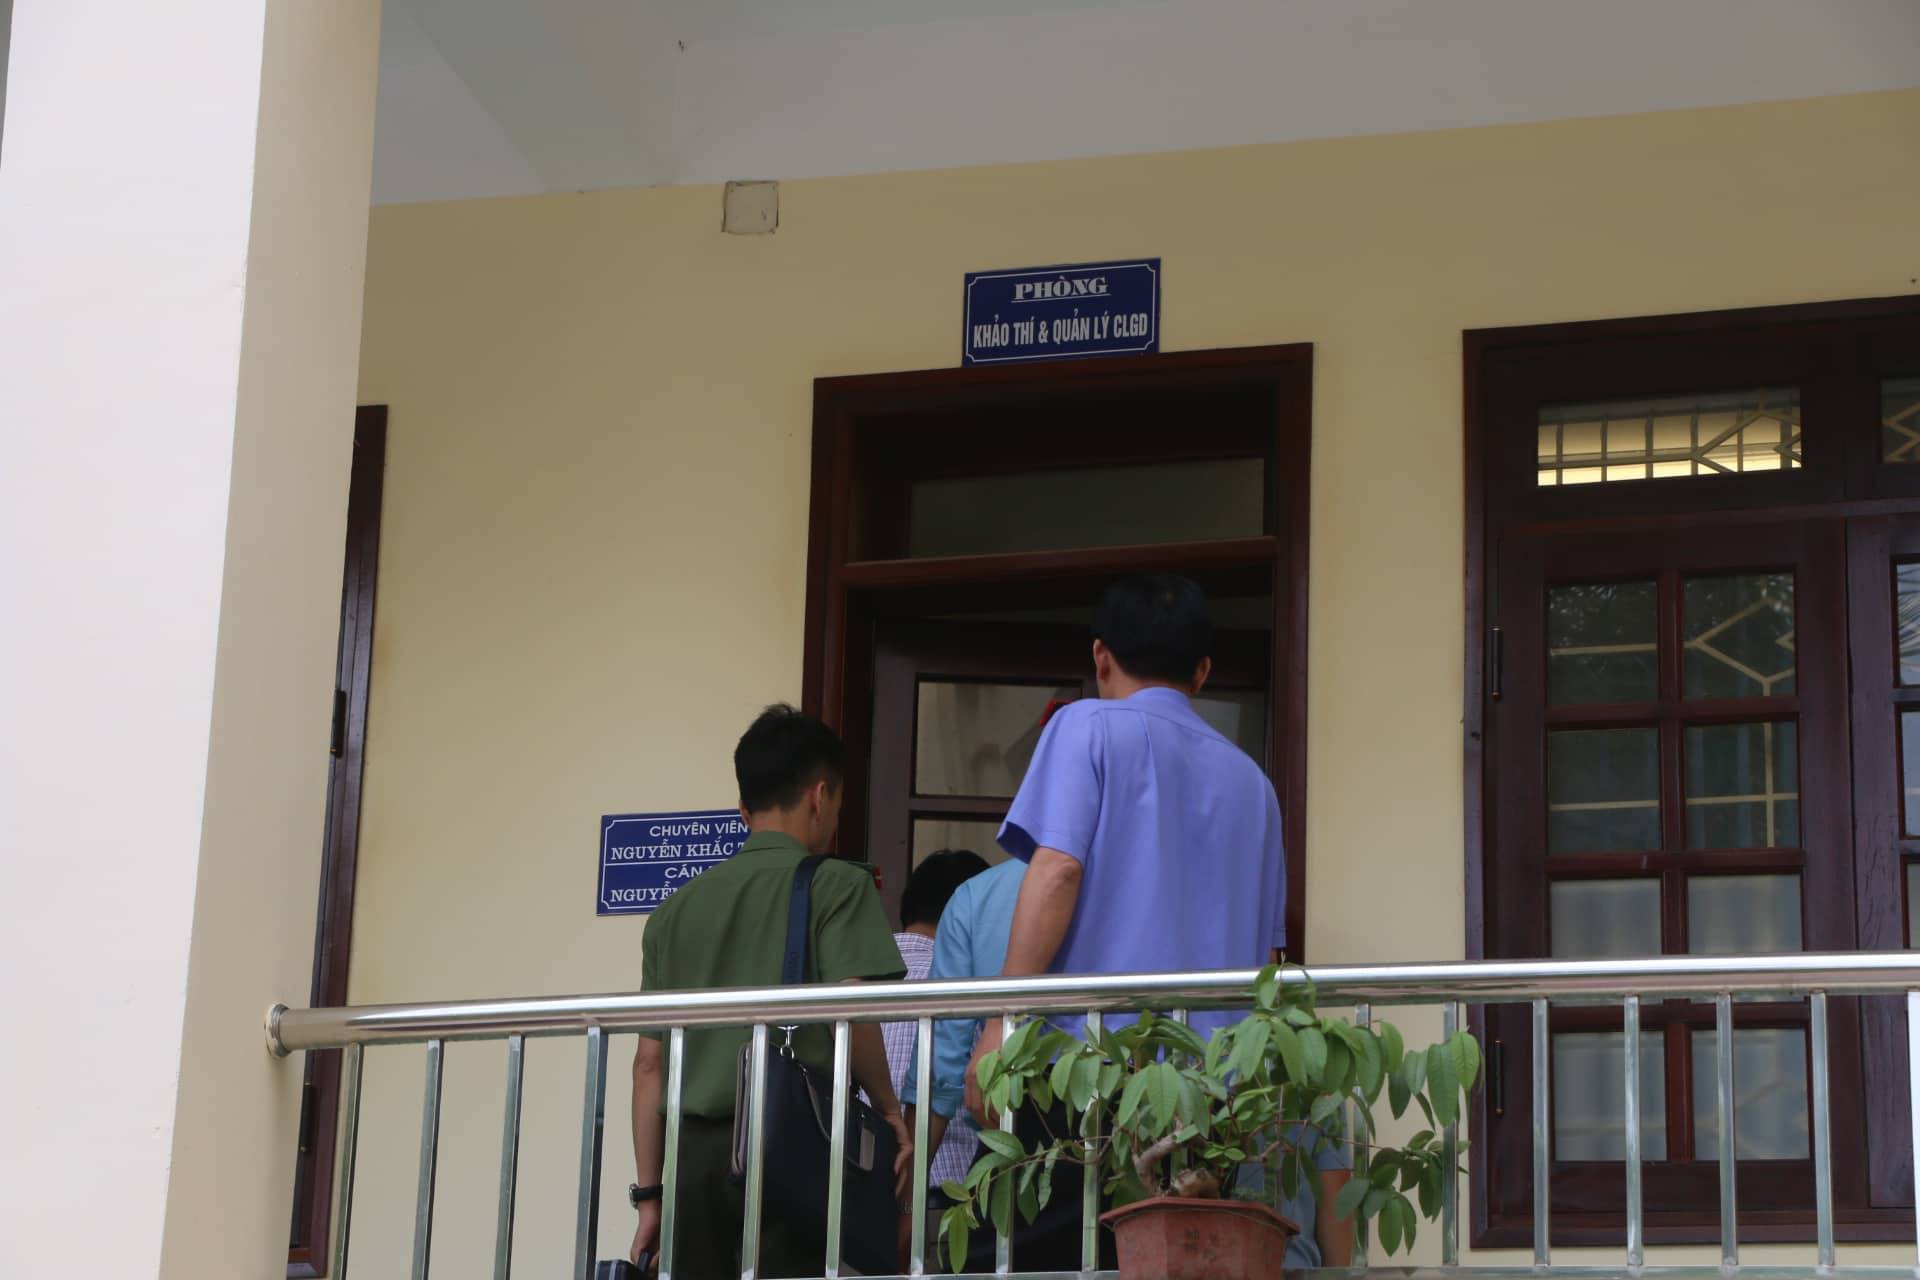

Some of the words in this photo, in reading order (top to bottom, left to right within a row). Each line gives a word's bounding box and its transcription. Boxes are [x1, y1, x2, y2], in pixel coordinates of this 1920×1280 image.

[1014, 275, 1109, 300] PHÒNG
[973, 314, 1010, 348] KHẢO
[1013, 316, 1035, 345] THÍ
[1038, 320, 1049, 344] &
[1052, 308, 1090, 345] QUẢN
[1093, 310, 1110, 340] LÝ
[1113, 312, 1148, 338] CLGD
[649, 822, 710, 837] CHUYÊN
[715, 820, 749, 834] VIÊN
[611, 839, 682, 861] NGUYỄN
[686, 836, 733, 857] KHẮC
[664, 864, 703, 879] CÁN
